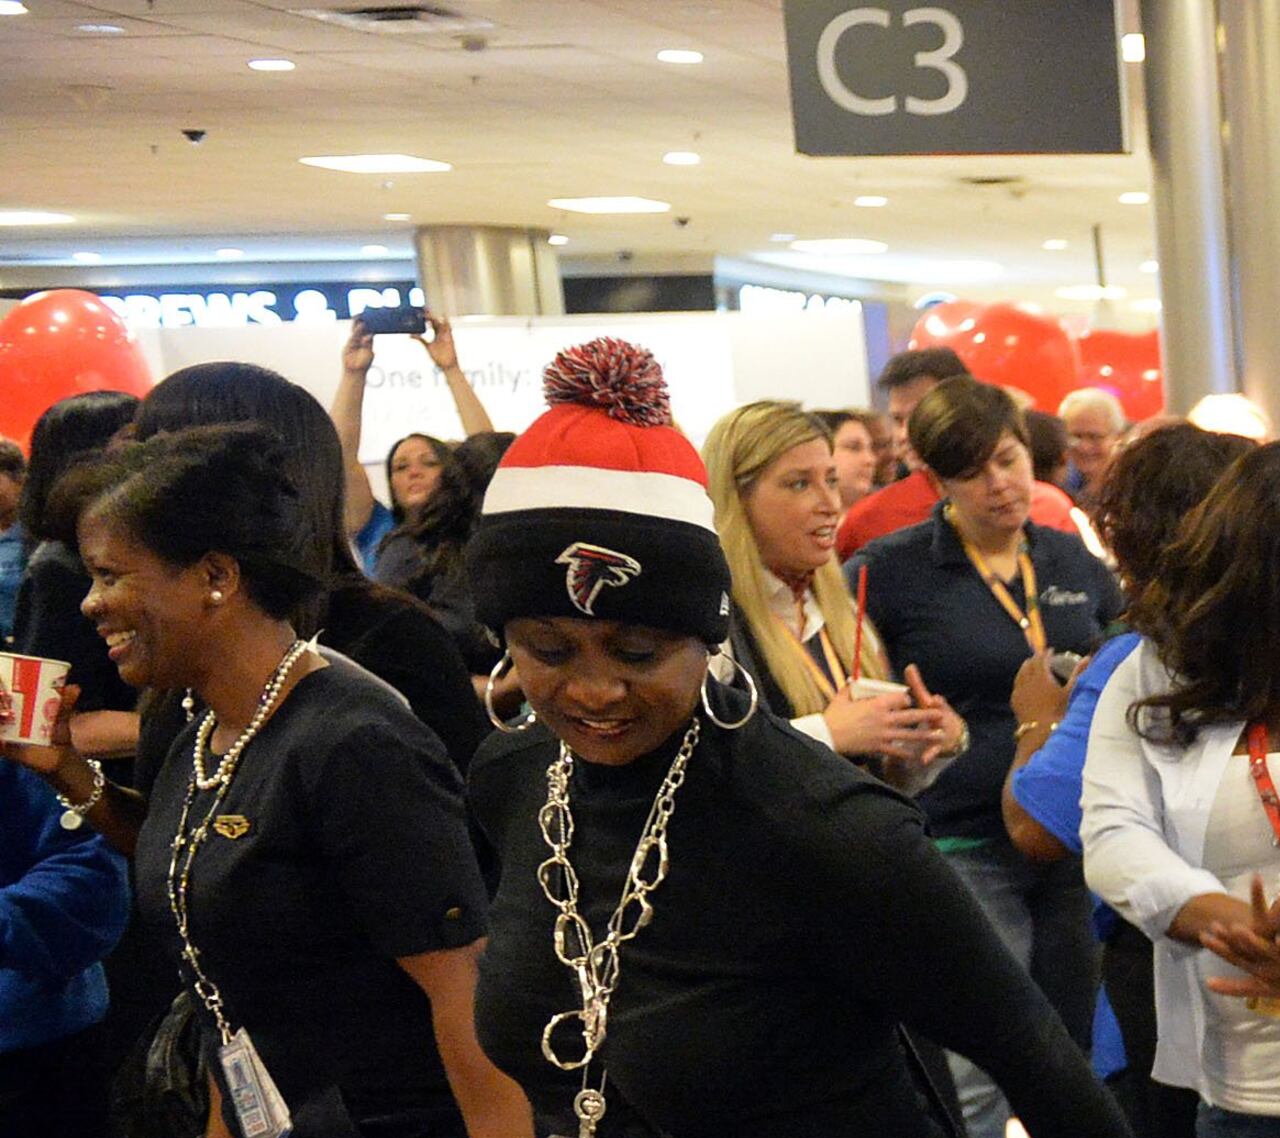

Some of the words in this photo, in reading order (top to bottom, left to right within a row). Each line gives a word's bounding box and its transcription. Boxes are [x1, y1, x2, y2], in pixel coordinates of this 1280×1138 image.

[816, 7, 969, 116] C3
[366, 365, 422, 389] One
[433, 360, 531, 393] fmily:
